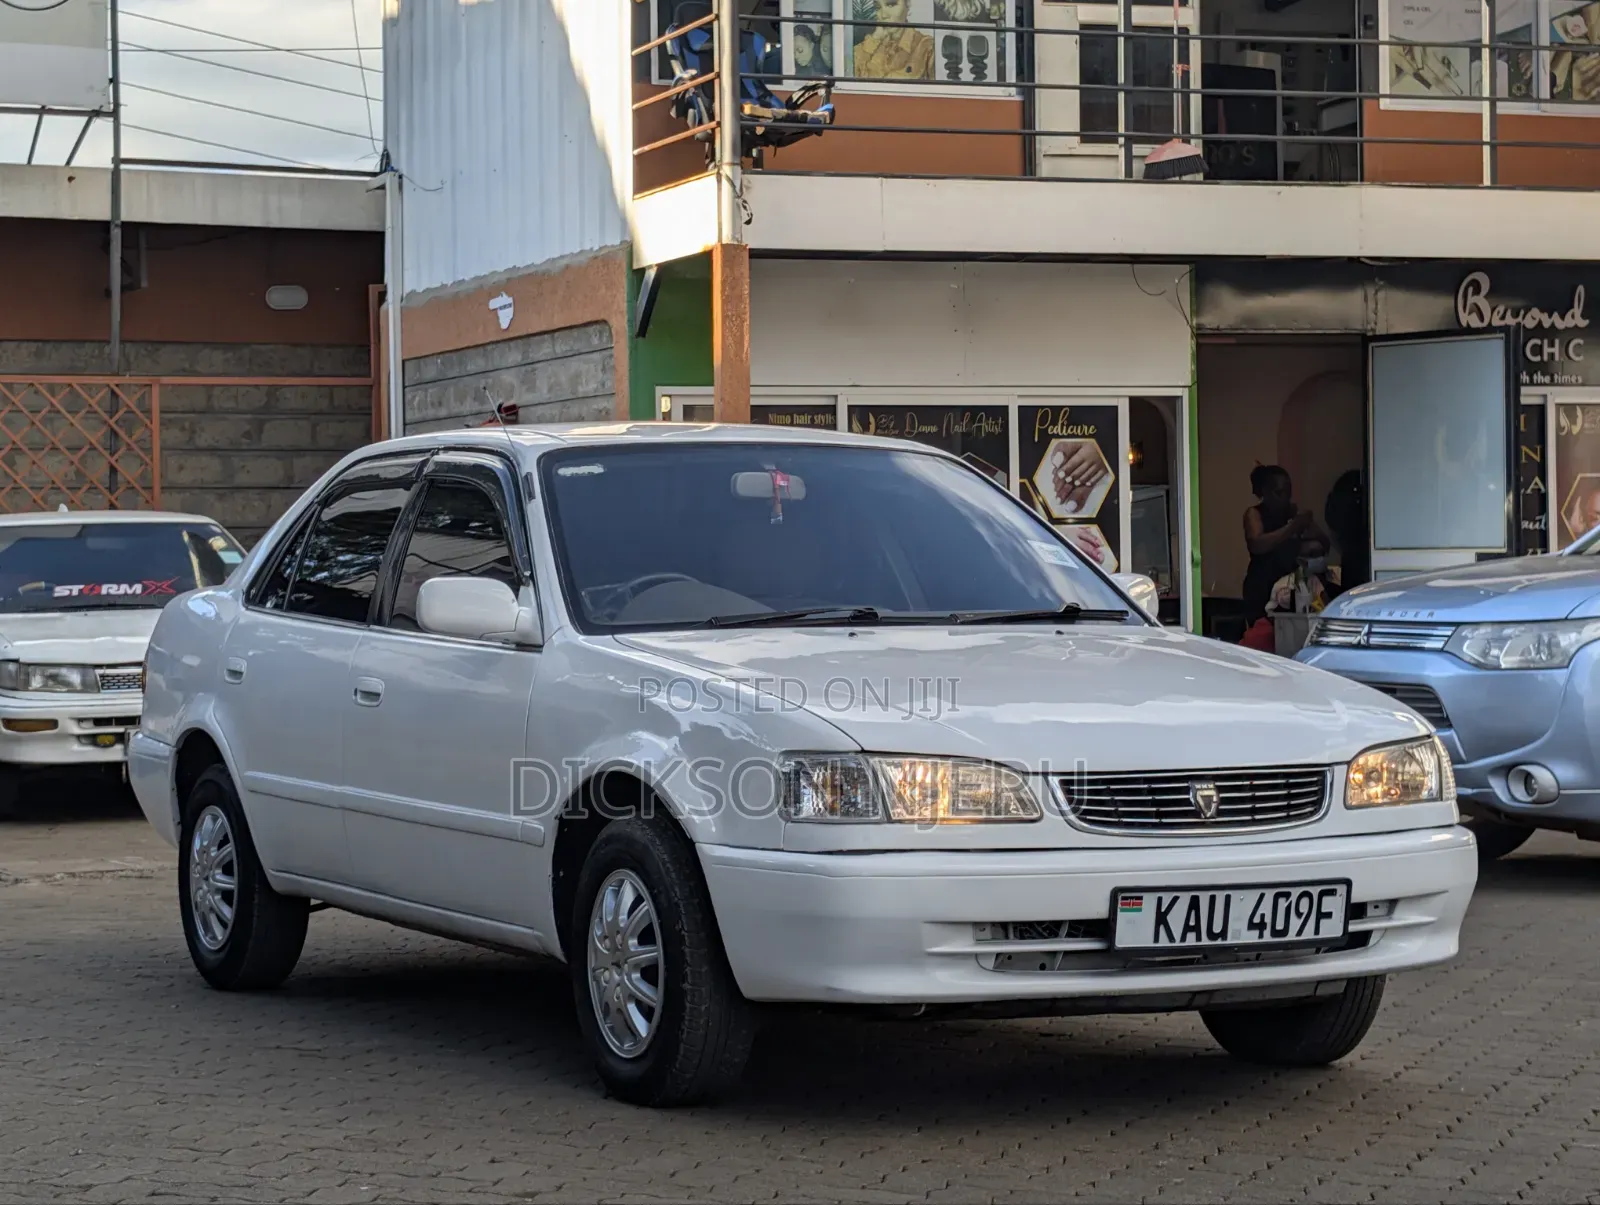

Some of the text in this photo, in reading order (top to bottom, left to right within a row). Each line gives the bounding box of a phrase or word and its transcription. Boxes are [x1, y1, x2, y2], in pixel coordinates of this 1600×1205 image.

[1457, 271, 1590, 329] Beyond
[1533, 371, 1551, 384] the
[1554, 371, 1583, 384] times
[793, 413, 812, 425] hair
[942, 412, 970, 438] Nail
[971, 411, 1004, 437] Artist
[1034, 407, 1097, 442] Pedicure
[1152, 887, 1339, 944] KAU 409F
